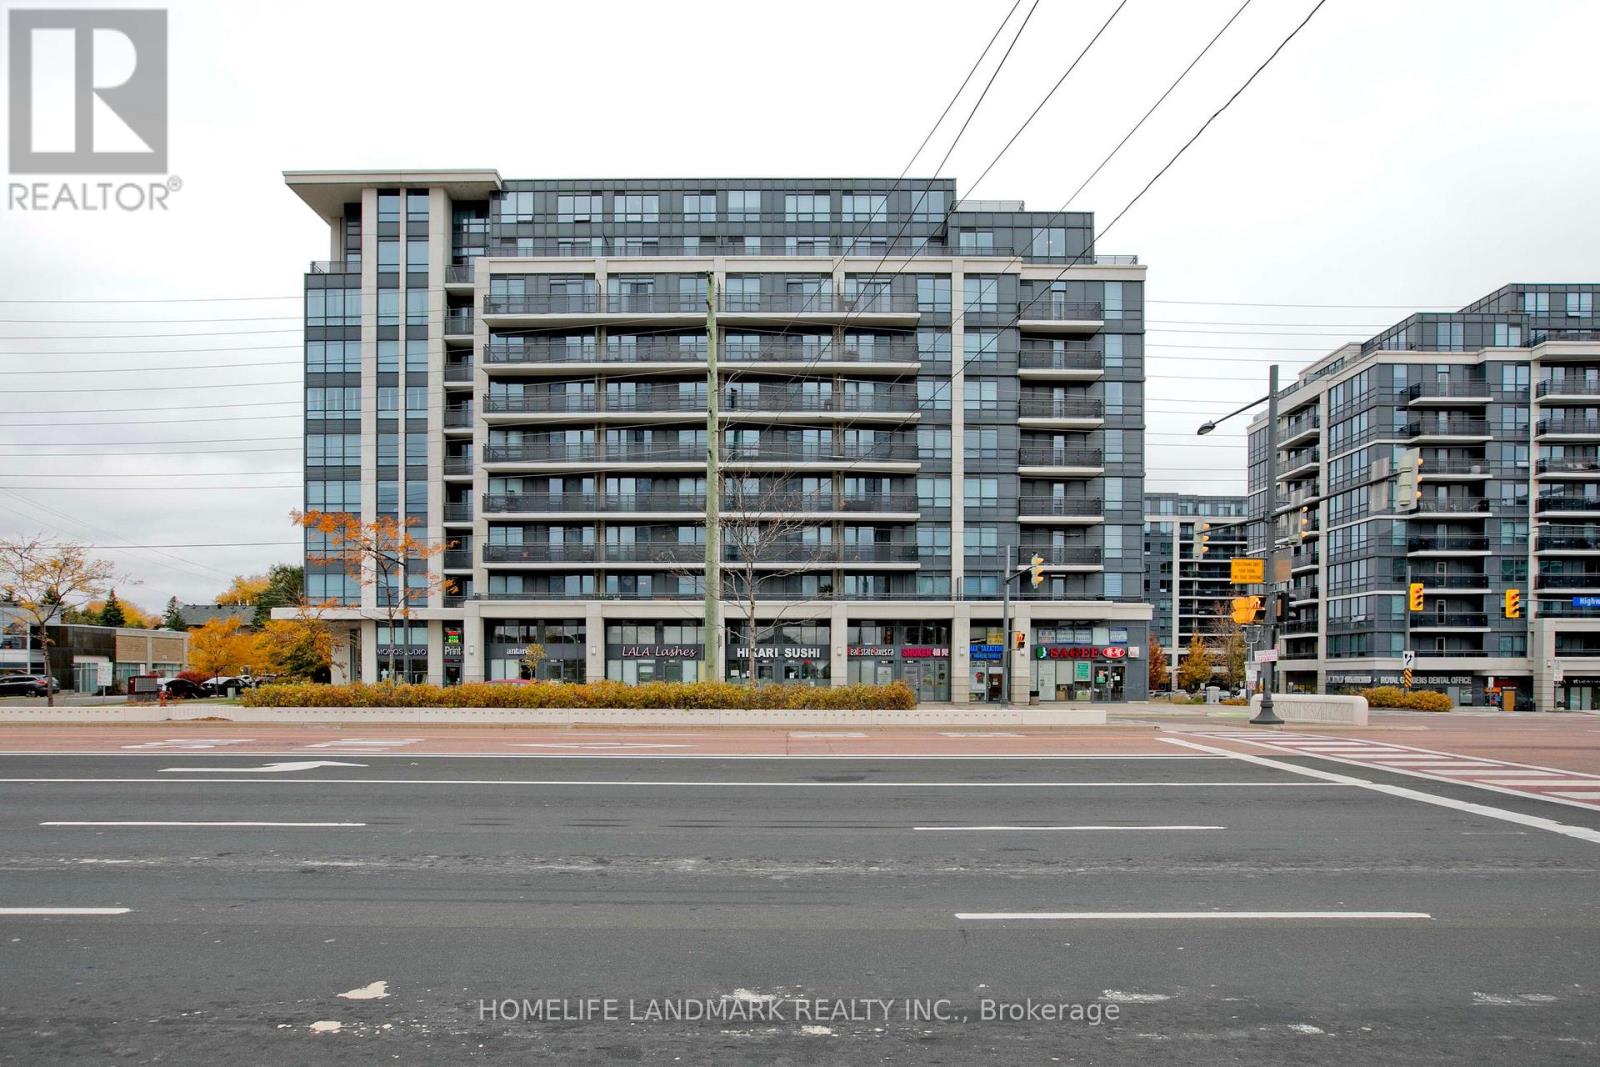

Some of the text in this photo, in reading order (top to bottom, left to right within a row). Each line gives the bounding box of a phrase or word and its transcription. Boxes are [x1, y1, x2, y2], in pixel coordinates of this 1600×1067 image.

[444, 645, 461, 656] Print
[622, 645, 697, 657] LALA Lashes
[784, 647, 820, 658] SUSHI
[1380, 676, 1399, 684] ROYAL
[1400, 676, 1428, 684] GDENS
[1428, 676, 1451, 684] DENTAL
[1450, 676, 1472, 684] OFFICE
